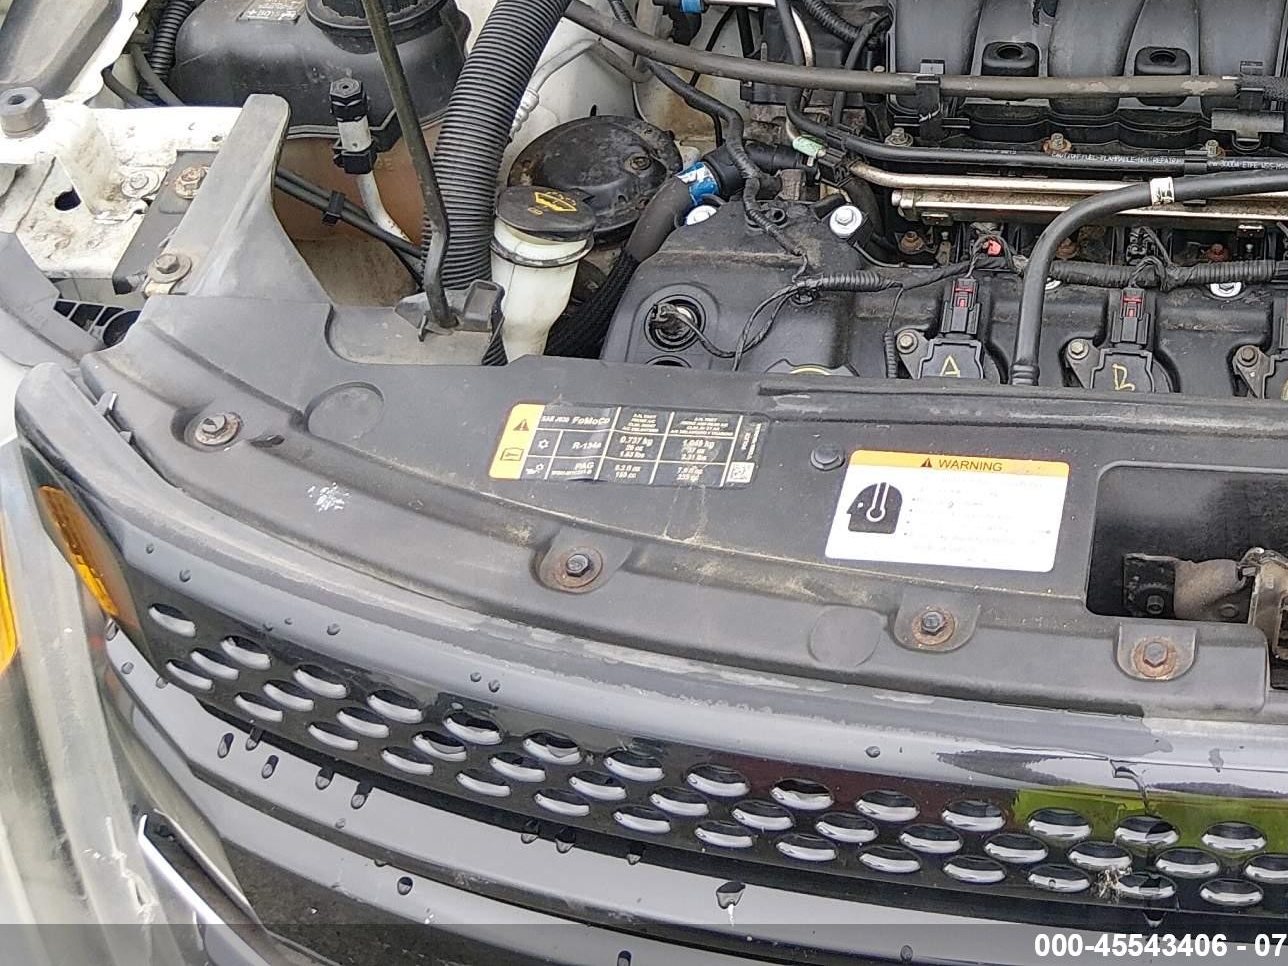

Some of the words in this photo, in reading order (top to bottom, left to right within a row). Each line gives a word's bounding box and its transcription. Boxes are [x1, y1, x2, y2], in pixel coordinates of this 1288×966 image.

[940, 355, 960, 378] A
[571, 416, 611, 426] FoMoCo
[938, 459, 1003, 472] WARNING
